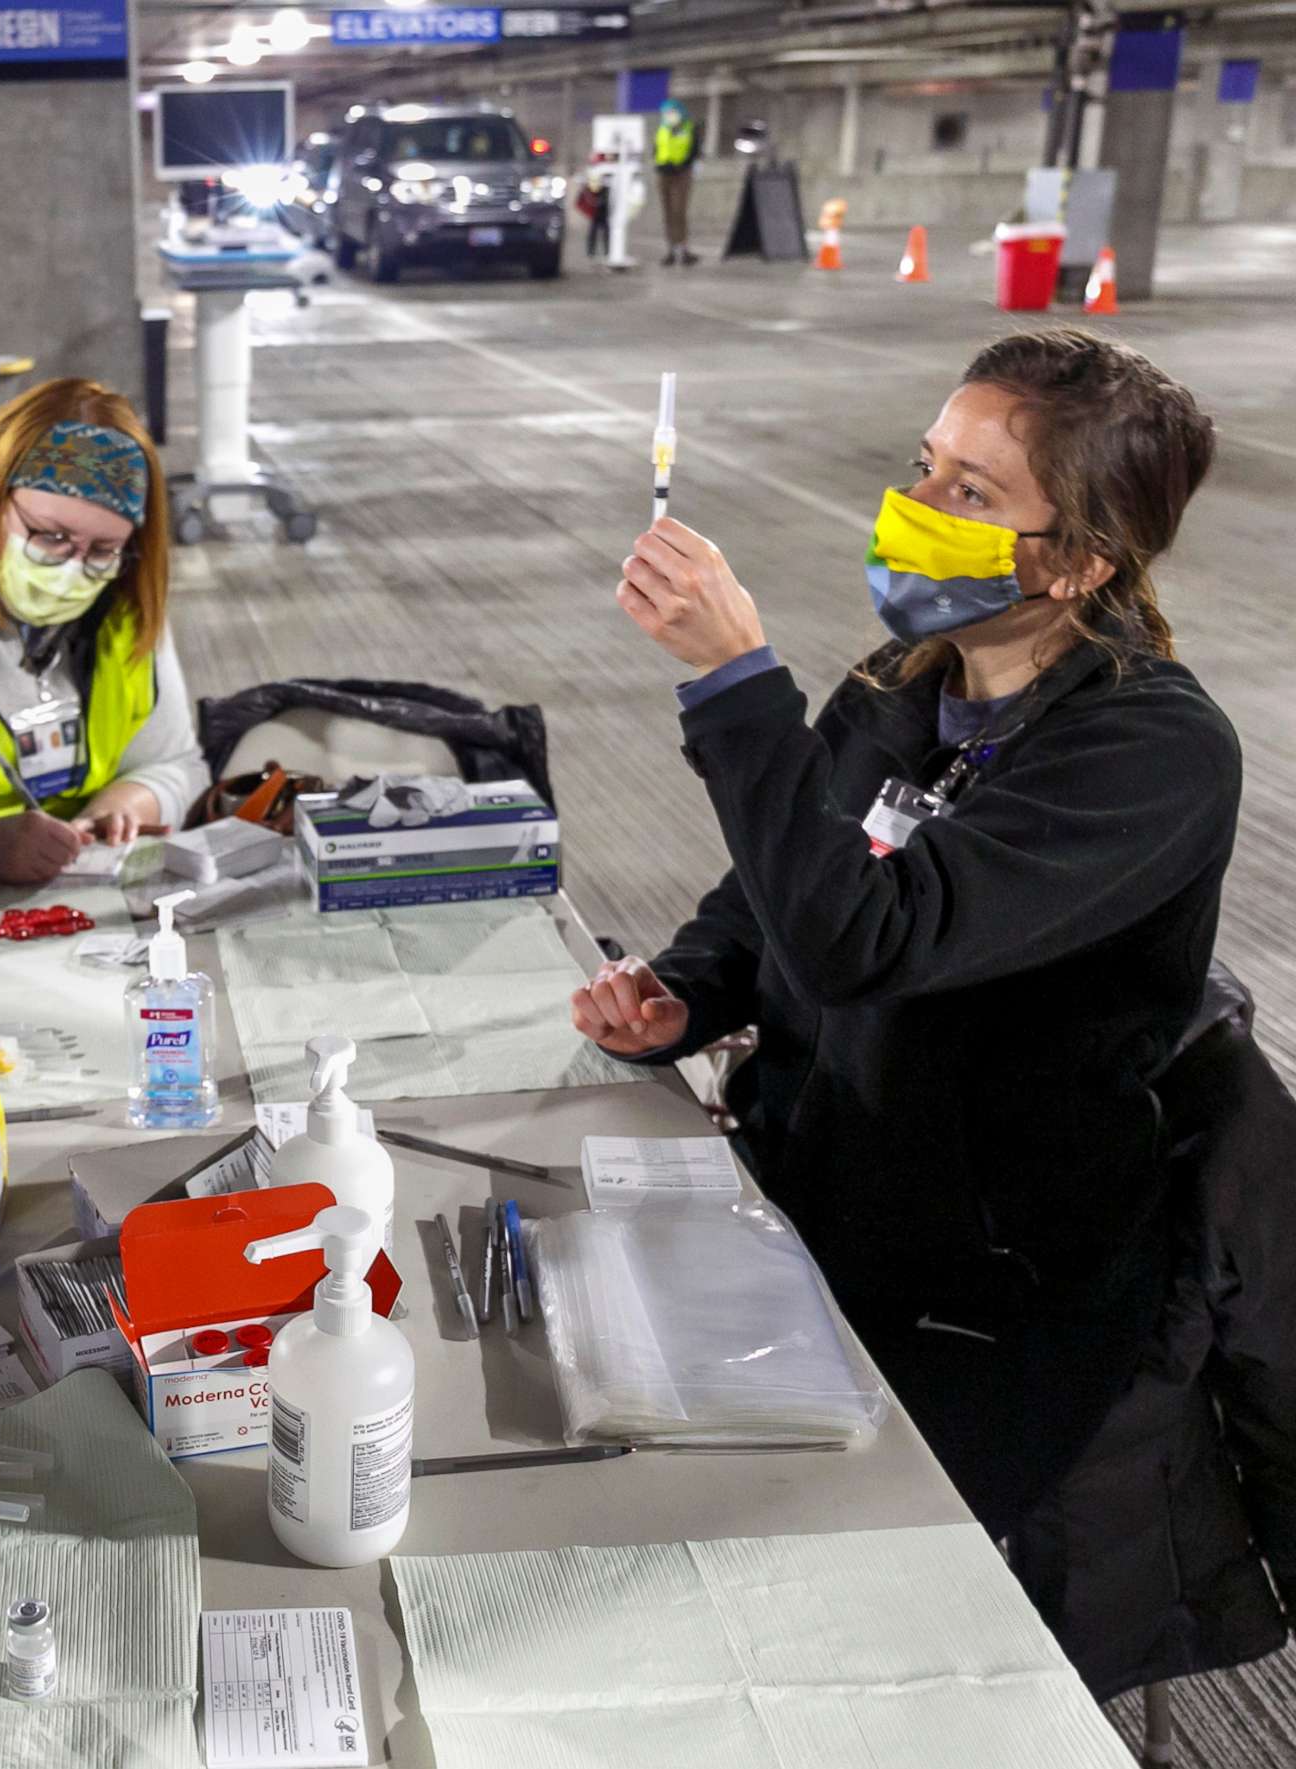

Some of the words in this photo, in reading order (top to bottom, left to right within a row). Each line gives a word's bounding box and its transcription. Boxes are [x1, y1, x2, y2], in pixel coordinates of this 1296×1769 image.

[336, 12, 497, 39] ELEVATORS
[165, 1373, 208, 1385] moderna
[165, 1387, 244, 1408] Moderna
[339, 1639, 350, 1673] Vaccination
[345, 1674, 355, 1695] Record
[347, 1695, 357, 1711] Card
